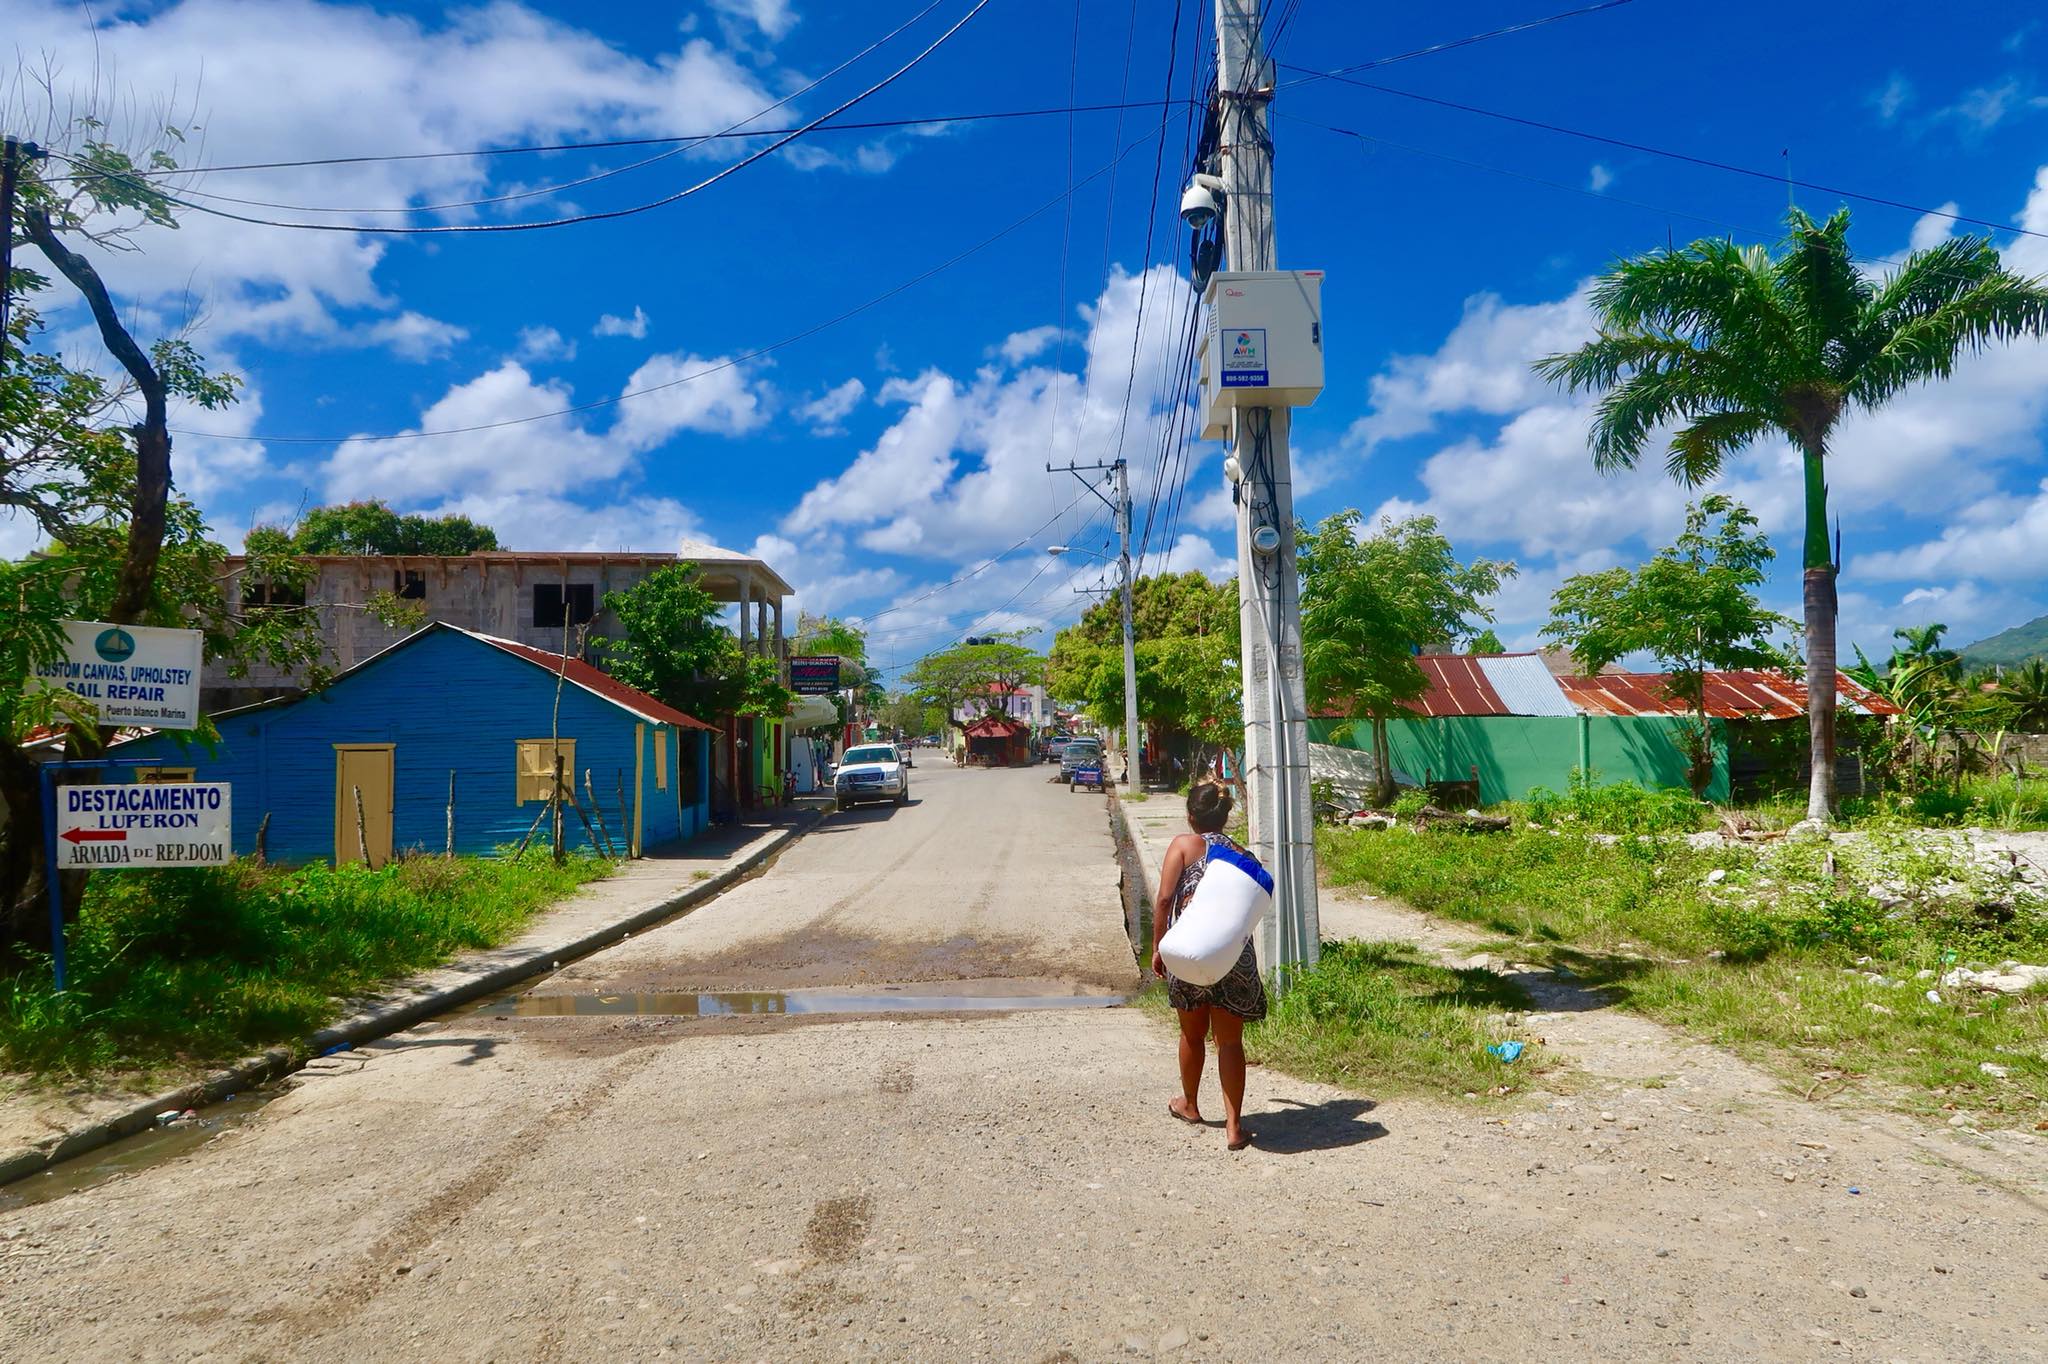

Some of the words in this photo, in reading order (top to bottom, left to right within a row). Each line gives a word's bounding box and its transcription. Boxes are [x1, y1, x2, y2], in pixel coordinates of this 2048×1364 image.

[36, 662, 81, 678] CUSTOM
[83, 664, 128, 684] CANVAS,
[131, 666, 192, 685] UPHOLSTEY
[107, 685, 165, 702] REPAIR
[106, 705, 132, 717] Puerto
[133, 706, 159, 718] blanco
[160, 707, 186, 719] Marina
[68, 787, 221, 812] DESTACAMENTO
[98, 813, 199, 829] LUPERON
[69, 845, 131, 864] ARMADA
[133, 848, 153, 858] DE
